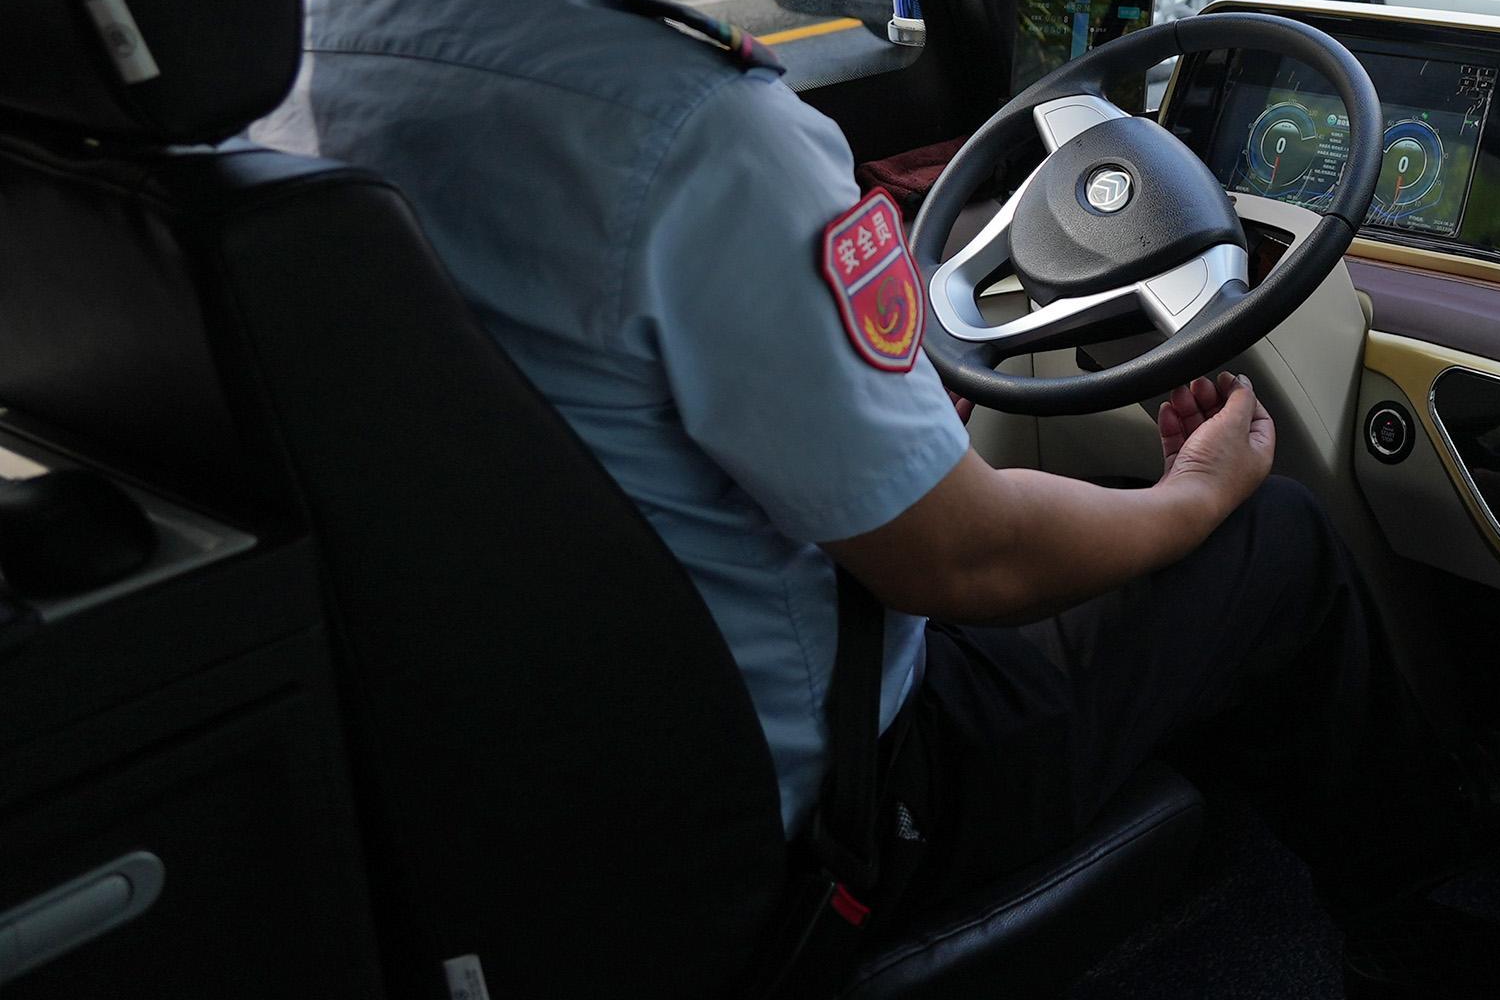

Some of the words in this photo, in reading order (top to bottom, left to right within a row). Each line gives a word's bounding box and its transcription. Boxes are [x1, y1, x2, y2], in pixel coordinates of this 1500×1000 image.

[1398, 156, 1409, 173] 0
[837, 210, 892, 276] 安全员
